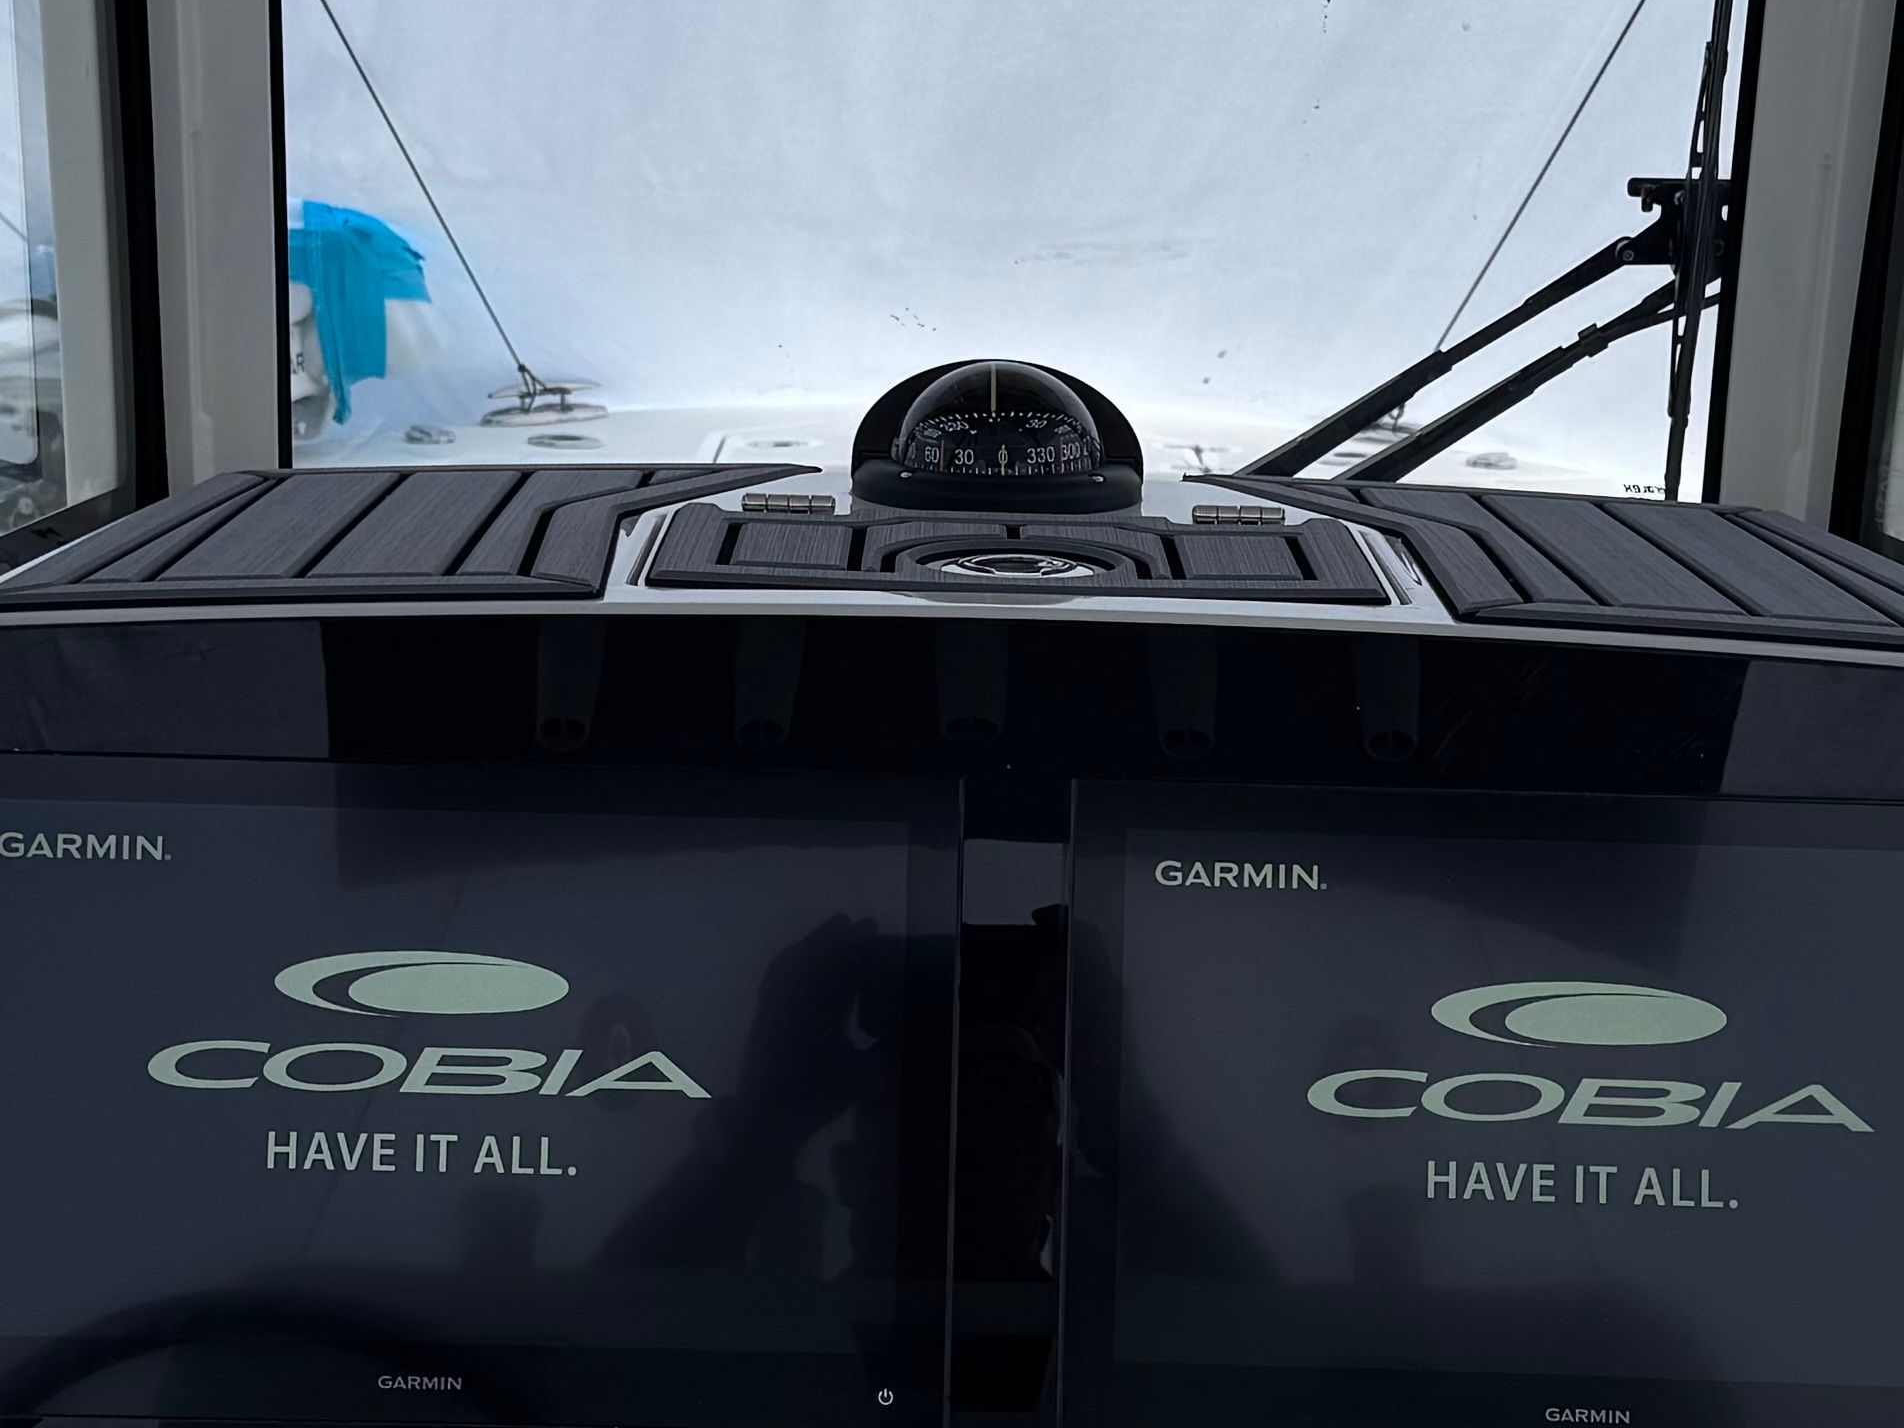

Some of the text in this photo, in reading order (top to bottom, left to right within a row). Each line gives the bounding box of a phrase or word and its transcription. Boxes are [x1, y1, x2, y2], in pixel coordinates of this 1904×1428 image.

[955, 448, 974, 465] 30
[1026, 446, 1056, 464] 330
[146, 1039, 712, 1099] COBIA
[1306, 1069, 1876, 1133] COBIA
[266, 1130, 577, 1176] HAVE IT ALL.
[1427, 1160, 1739, 1209] HAVE IT ALL.
[377, 1375, 463, 1391] GARMIN
[1545, 1407, 1631, 1424] GARMIN
